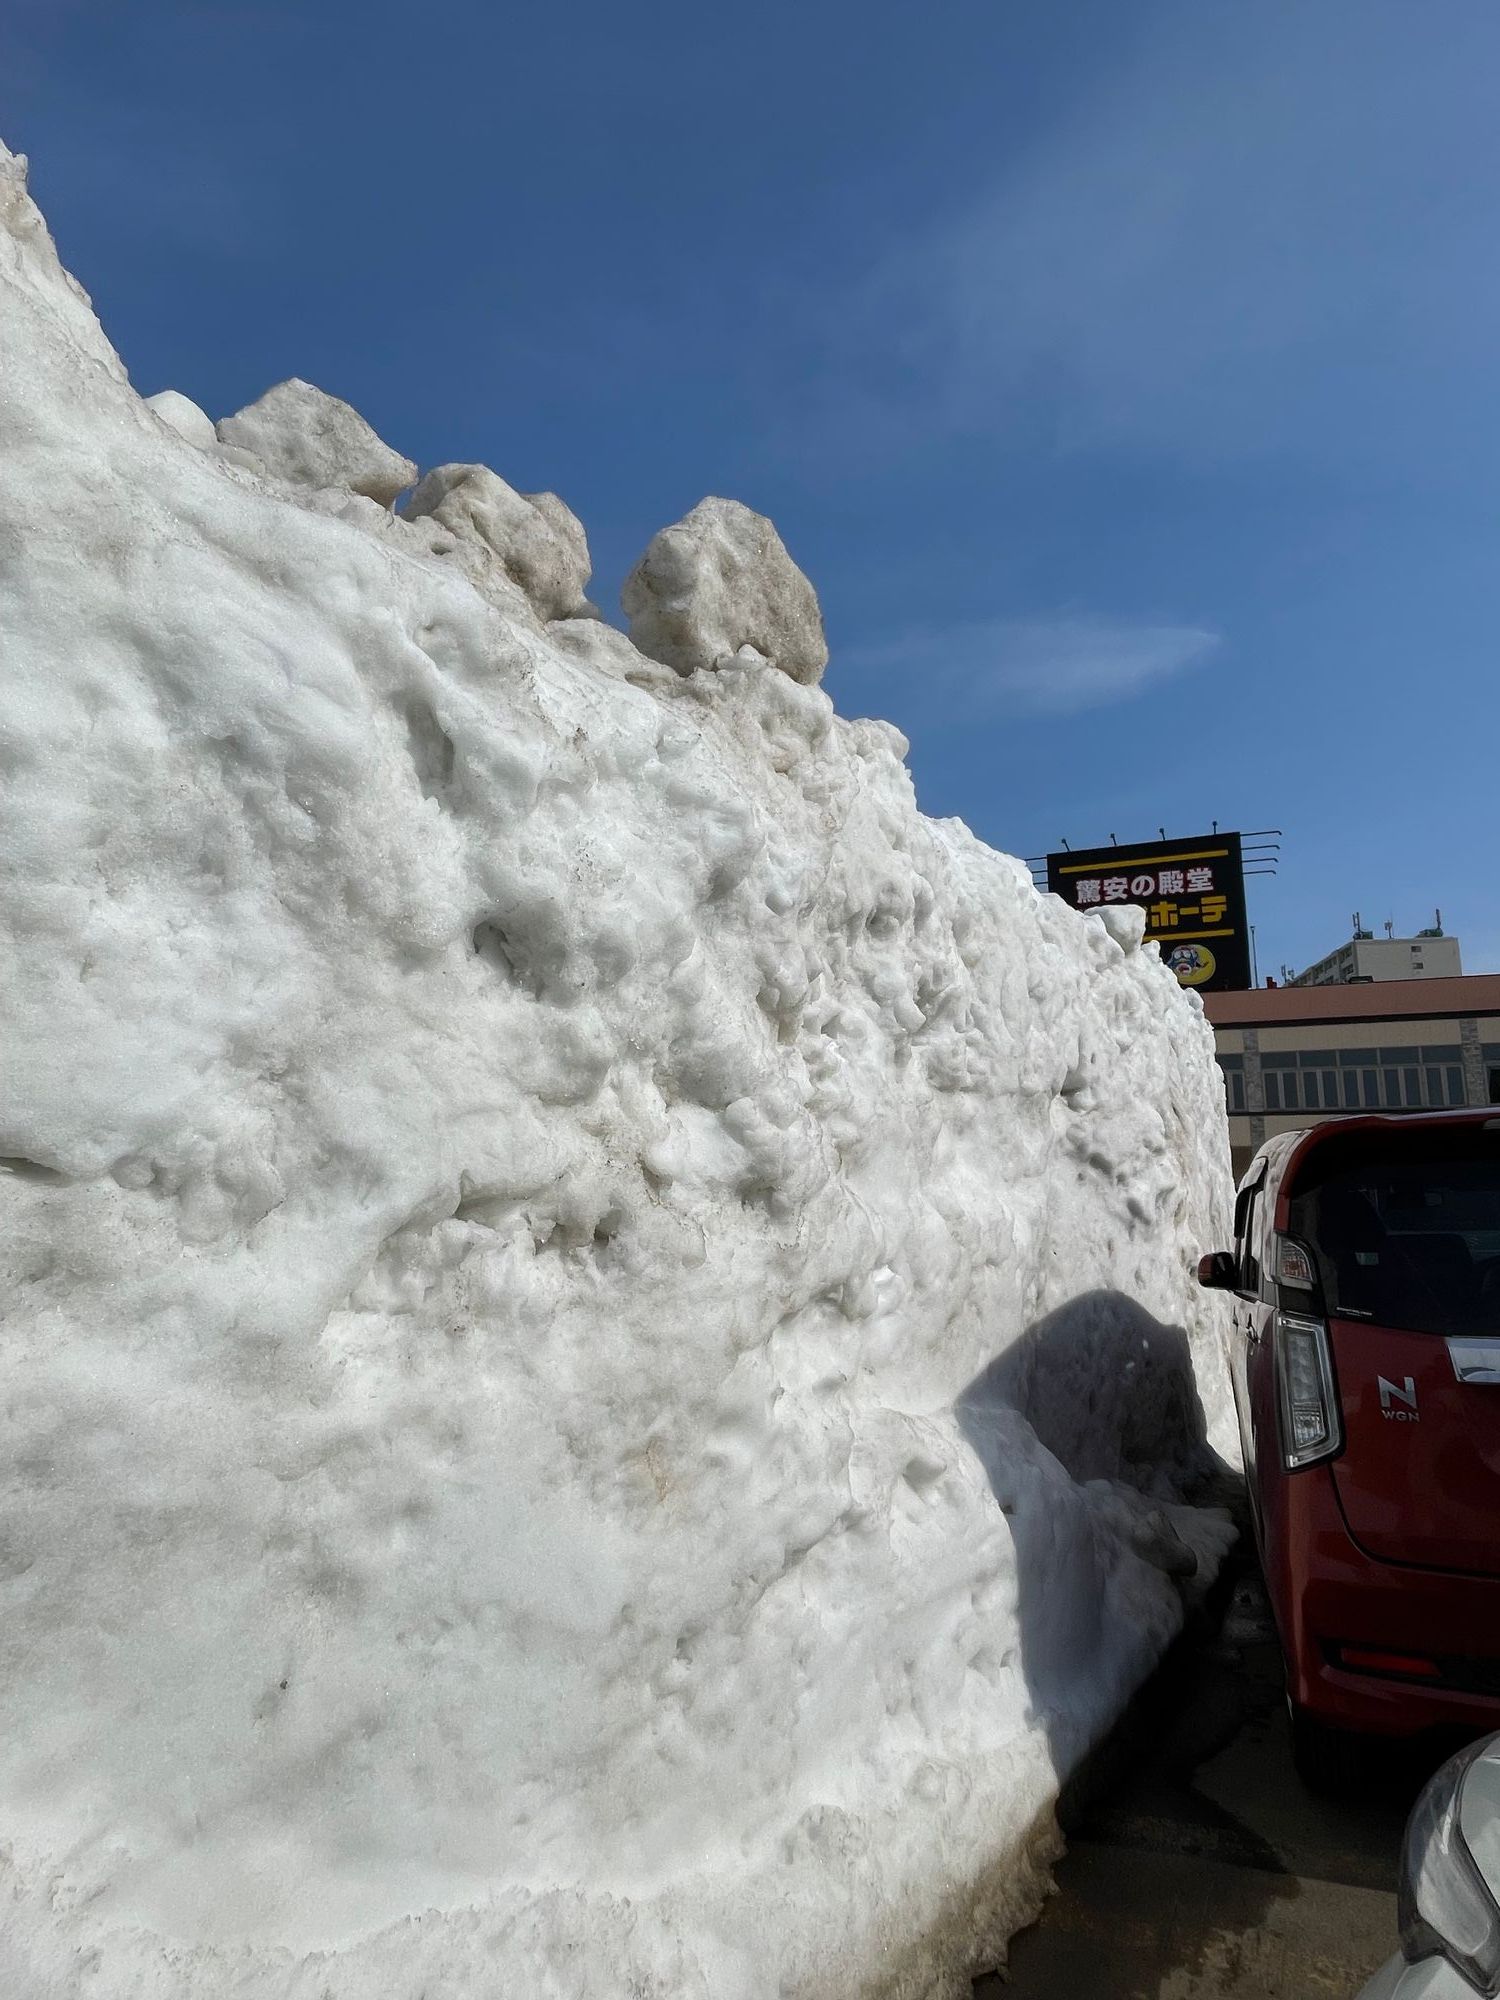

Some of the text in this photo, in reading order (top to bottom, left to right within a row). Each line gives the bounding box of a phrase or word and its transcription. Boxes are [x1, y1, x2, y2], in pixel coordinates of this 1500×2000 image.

[1076, 867, 1214, 904] 驚安の殿堂
[1145, 896, 1227, 927] ホーテ
[1377, 1375, 1417, 1408] N
[1381, 1410, 1420, 1422] WGN
